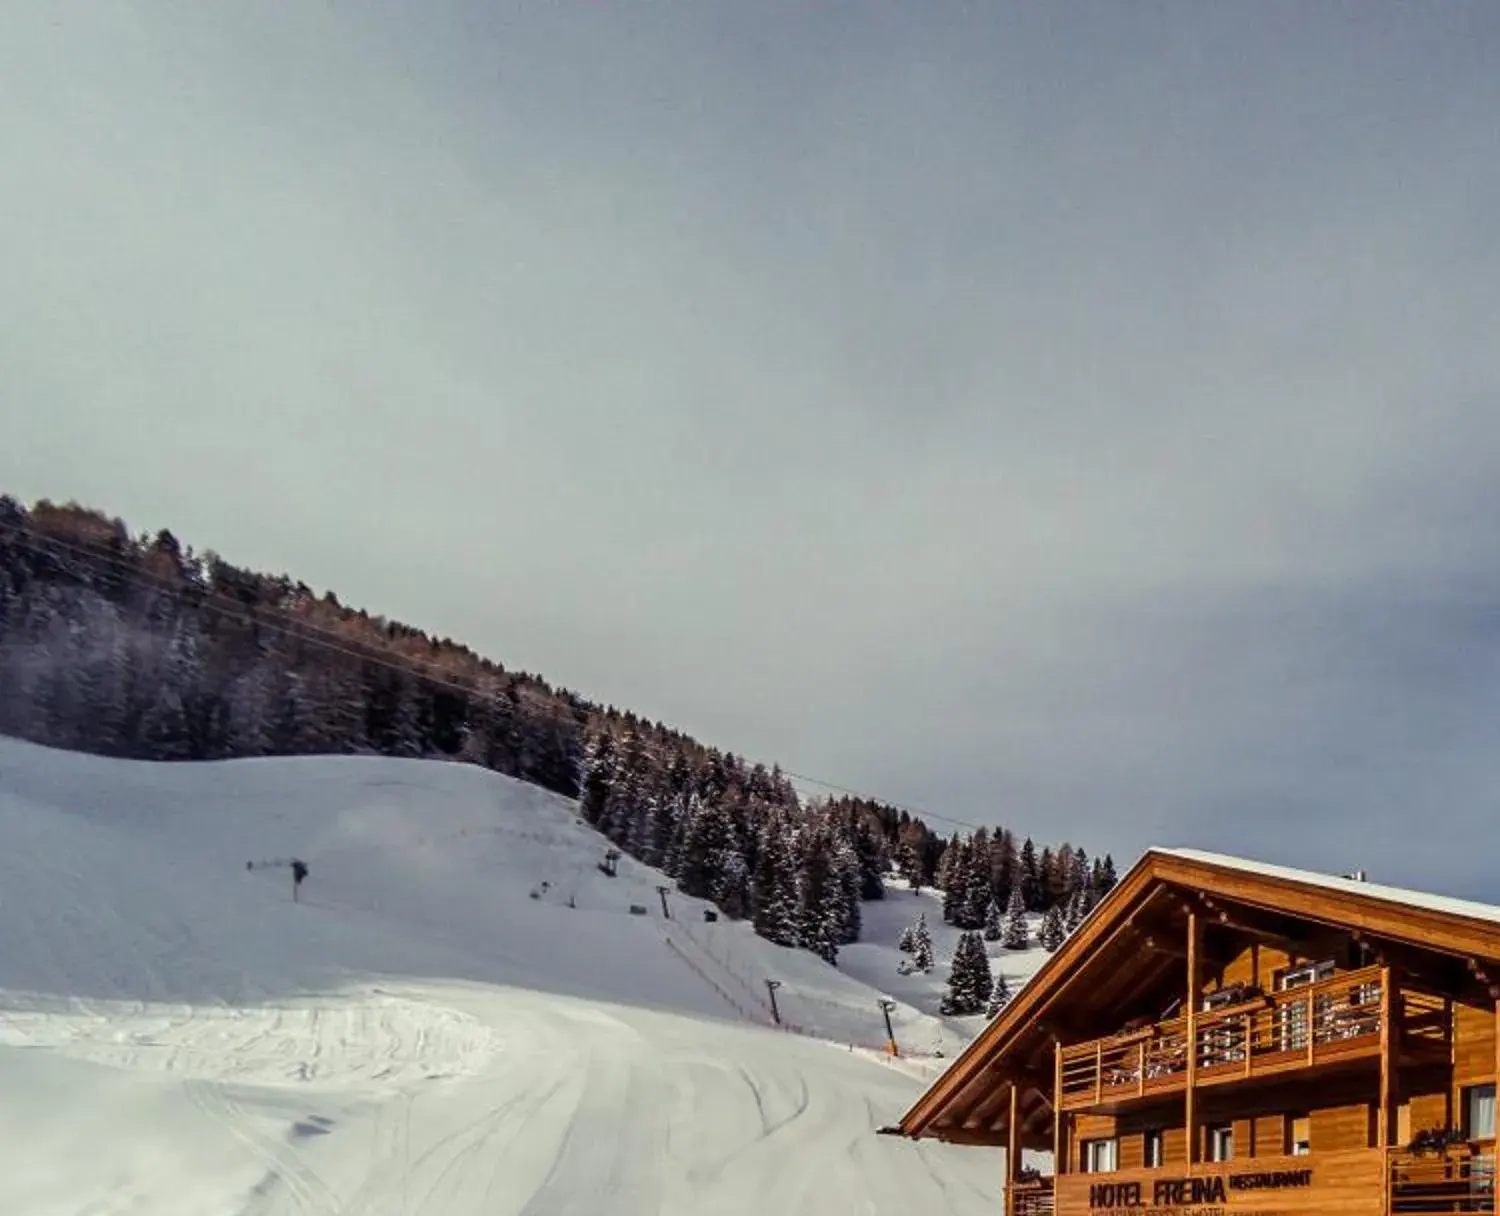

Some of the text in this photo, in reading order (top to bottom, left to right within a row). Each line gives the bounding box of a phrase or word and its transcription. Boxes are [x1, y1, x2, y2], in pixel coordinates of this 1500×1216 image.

[1089, 1169, 1313, 1209] HOTEL FREINA RESTAURANT
